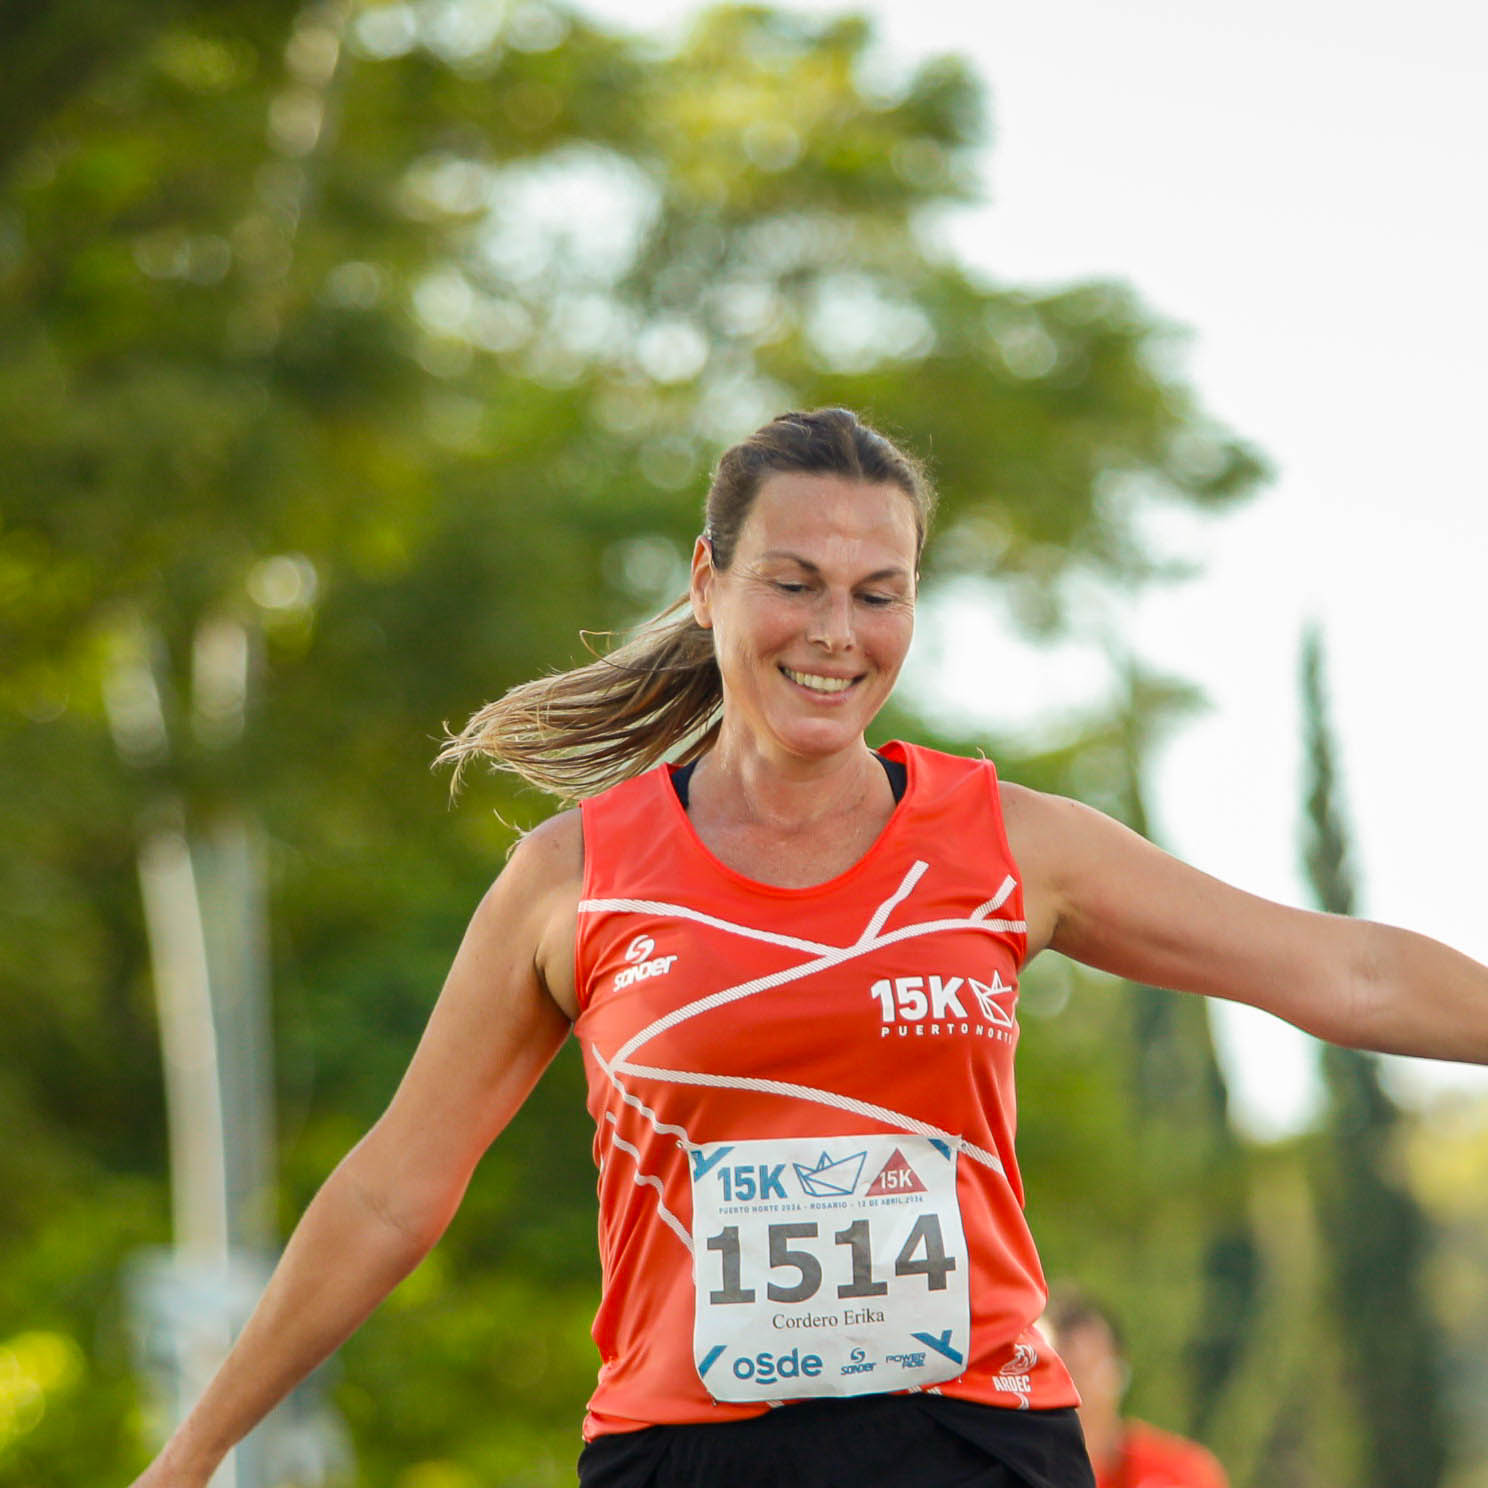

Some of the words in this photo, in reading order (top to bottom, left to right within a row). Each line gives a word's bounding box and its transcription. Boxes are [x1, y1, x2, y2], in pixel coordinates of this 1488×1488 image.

[870, 975, 968, 1022] 15K
[881, 1022, 969, 1038] PUERTO
[717, 1163, 788, 1201] 15K
[878, 1167, 914, 1190] 15K
[810, 1201, 848, 1209] ROSARIO
[707, 1213, 956, 1305] 1514
[772, 1313, 839, 1329] Cordero
[844, 1308, 885, 1325] Erika
[732, 1347, 824, 1380] osde
[992, 1375, 1031, 1393] ARDEC
